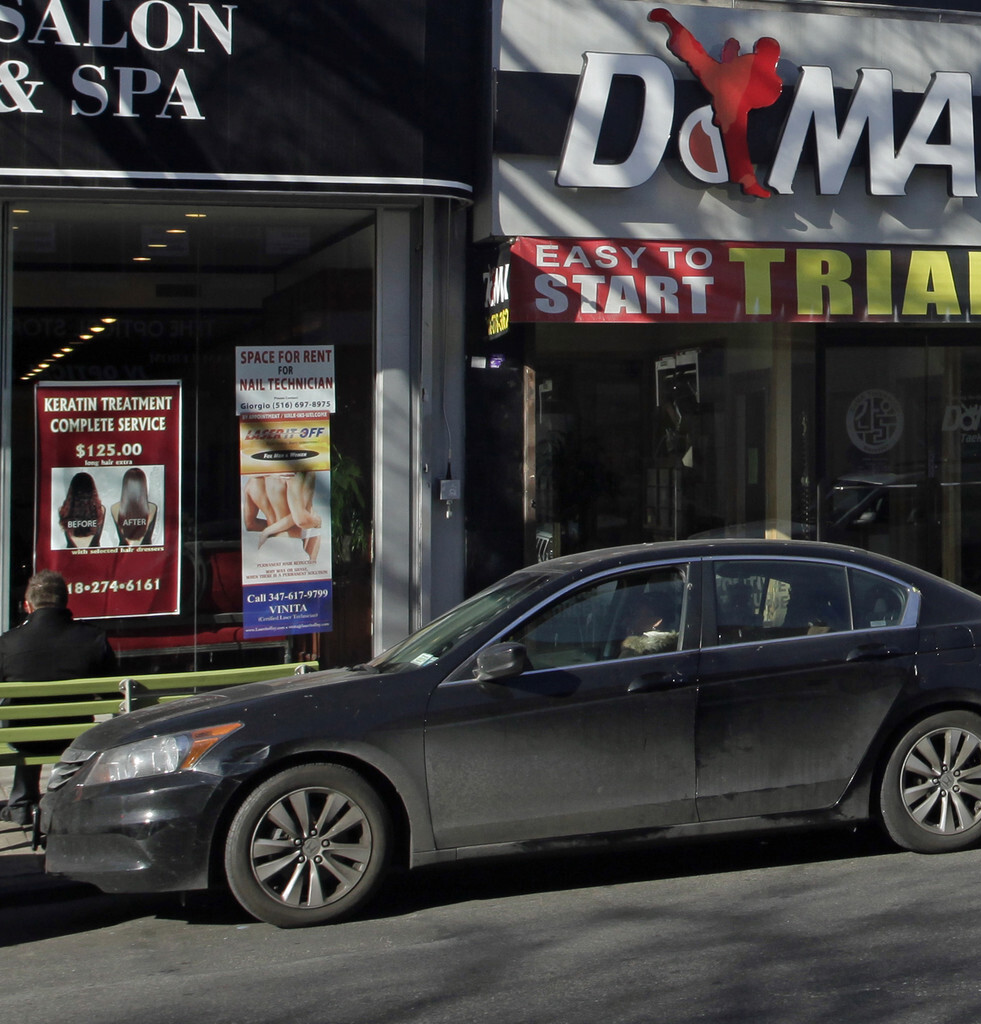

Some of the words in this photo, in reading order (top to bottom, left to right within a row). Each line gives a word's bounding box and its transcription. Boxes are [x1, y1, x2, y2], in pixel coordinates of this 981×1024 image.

[0, 59, 44, 114] &
[71, 64, 206, 121] SPA
[535, 244, 647, 269] EASY
[659, 246, 714, 270] TO
[535, 273, 715, 316] START
[240, 350, 275, 364] SPACE
[278, 350, 300, 364] FOR
[303, 349, 332, 363] RENT
[278, 365, 293, 375] FOR
[240, 378, 265, 391] NAIL
[268, 377, 333, 391] TECHNICIAN
[44, 397, 98, 412] KERATIN
[100, 396, 173, 411] TREATMENT
[240, 402, 271, 410] Giorgio
[272, 401, 293, 410] (516)
[294, 400, 331, 409] 697-8975
[50, 418, 114, 433] COMPLETE
[118, 417, 166, 432] SERVICE
[245, 429, 284, 440] LASER
[284, 428, 297, 439] IT
[299, 427, 325, 438] OFF
[75, 443, 143, 459] $125.00
[84, 459, 100, 467] long
[67, 519, 97, 528] BEFORE
[122, 518, 147, 527] AFTER
[90, 547, 119, 555] selected
[247, 593, 267, 603] Call
[268, 589, 329, 602] 347-617-9799
[269, 603, 308, 614] VINITA
